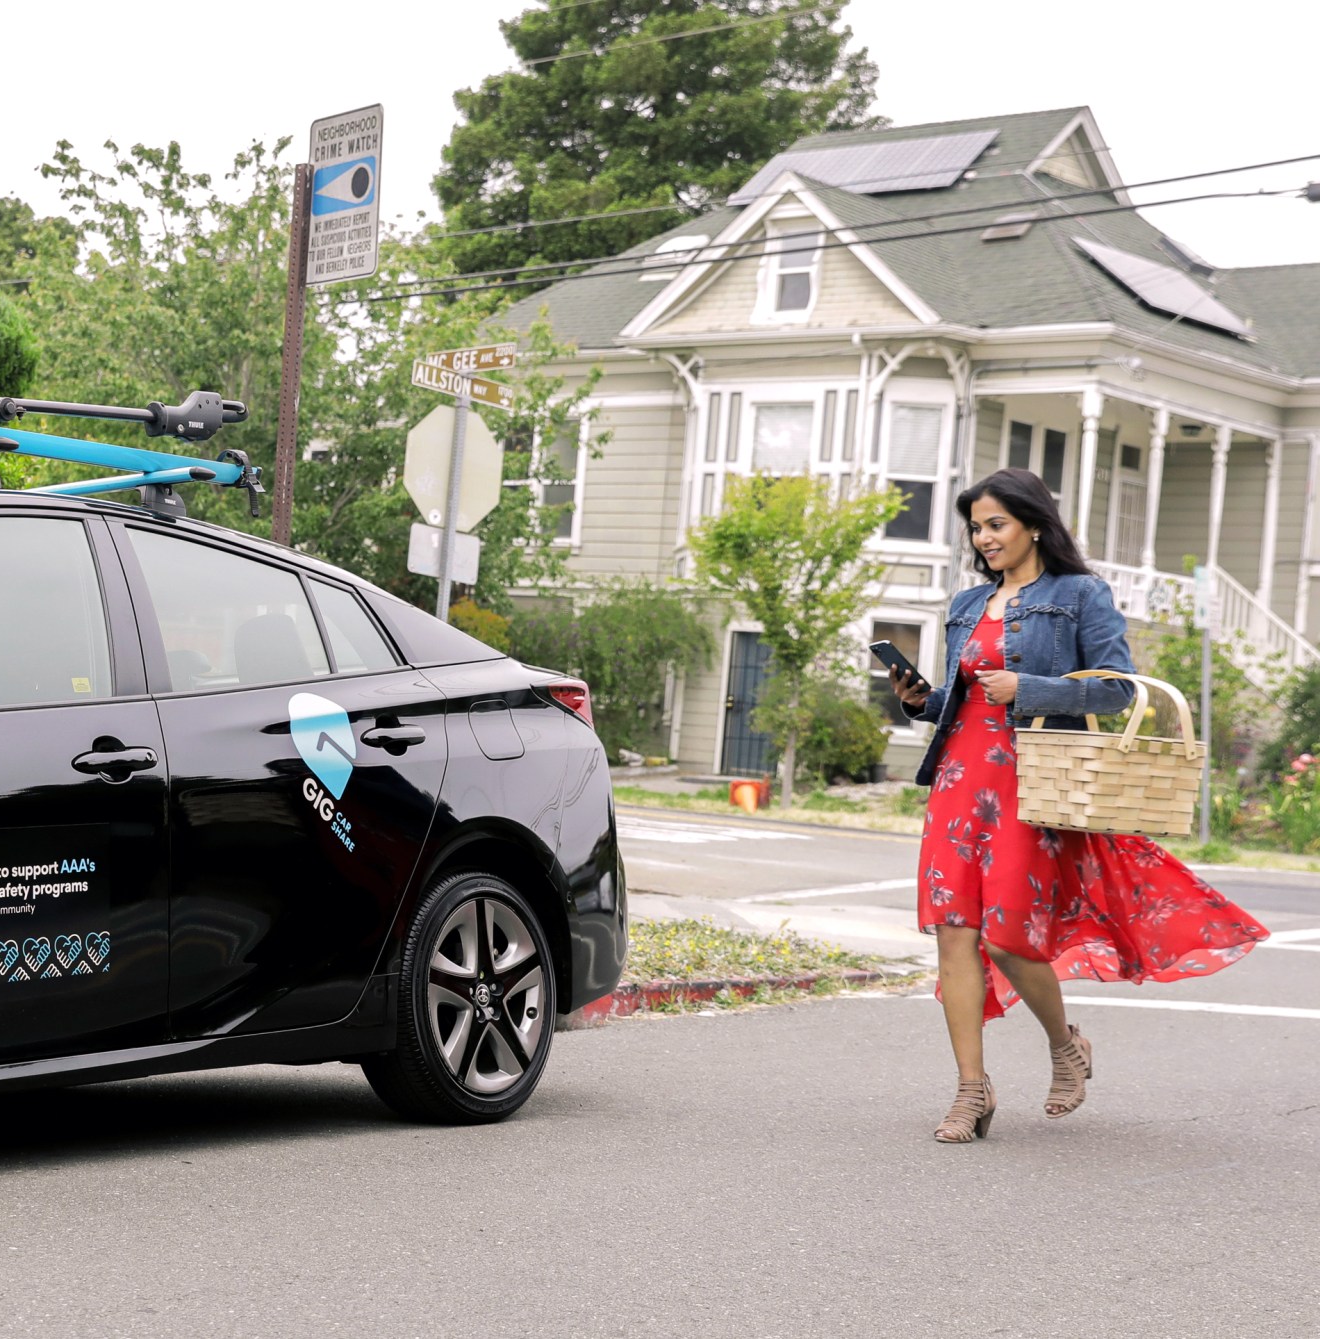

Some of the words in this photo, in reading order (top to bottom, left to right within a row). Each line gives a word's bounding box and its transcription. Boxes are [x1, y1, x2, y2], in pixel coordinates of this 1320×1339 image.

[317, 115, 377, 143] NEIGHBORHOOD
[314, 142, 343, 162] CRIME
[348, 133, 378, 154] WATCH
[314, 222, 321, 233] WE
[323, 215, 352, 231] IMMEDIATELY
[352, 211, 370, 225] REPORT
[311, 236, 319, 248] ALL
[321, 230, 346, 246] SUSPICIOUS
[348, 225, 371, 241] ACTIVITIES
[327, 245, 344, 259] FELLOW
[347, 239, 371, 255] NEIGHBORS
[315, 262, 324, 275] AND
[326, 258, 348, 273] BERKELEY
[349, 255, 364, 269] POLICE
[453, 350, 478, 370] GEE
[480, 352, 494, 363] AVE
[415, 364, 472, 396] ALLSTON
[302, 777, 335, 821] GIG
[335, 811, 352, 833] CAR
[330, 821, 356, 853] SHARE
[11, 861, 59, 883] support
[60, 858, 96, 873] AAA's
[32, 880, 89, 899] programs
